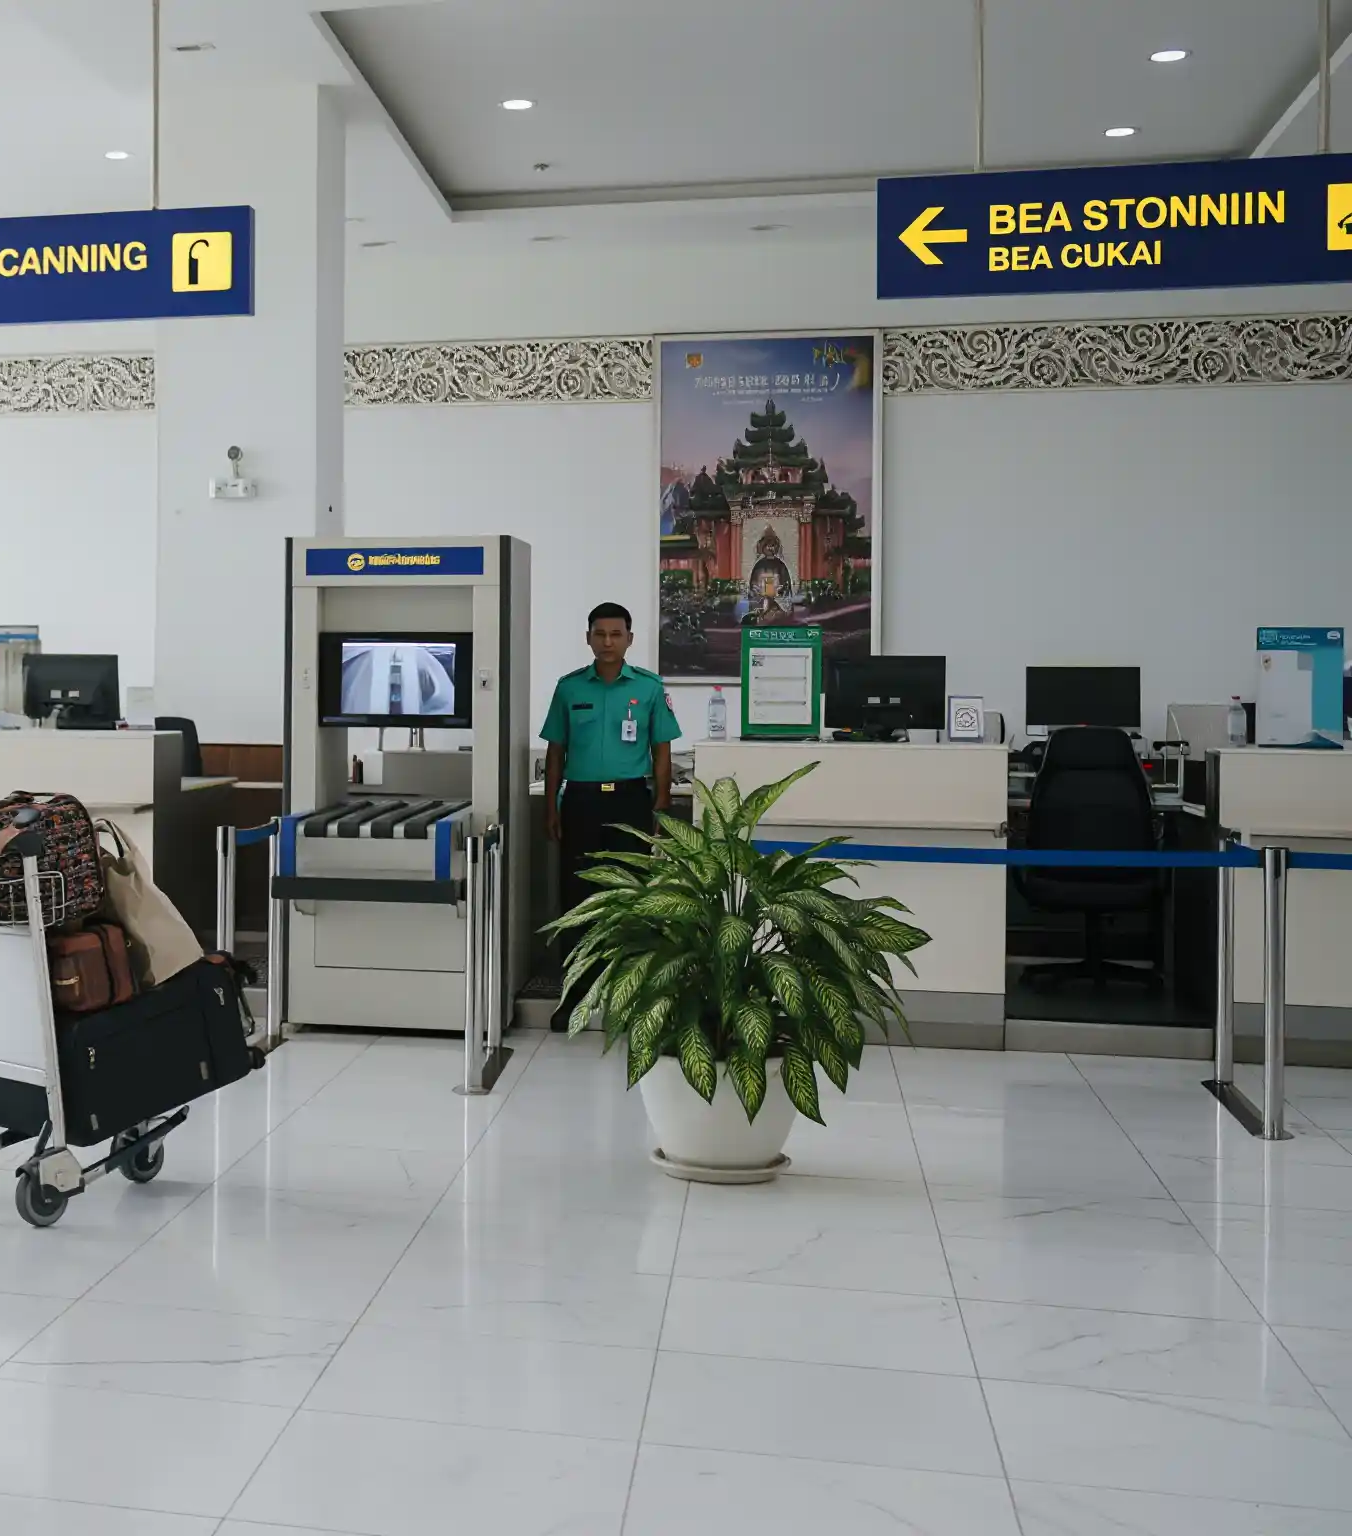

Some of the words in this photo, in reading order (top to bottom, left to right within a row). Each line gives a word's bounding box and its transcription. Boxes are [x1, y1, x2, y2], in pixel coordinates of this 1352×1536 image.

[988, 201, 1073, 236] BEA
[1082, 190, 1286, 232] STONNIIN
[988, 244, 1054, 272] BEA
[1060, 240, 1162, 269] CUKAI
